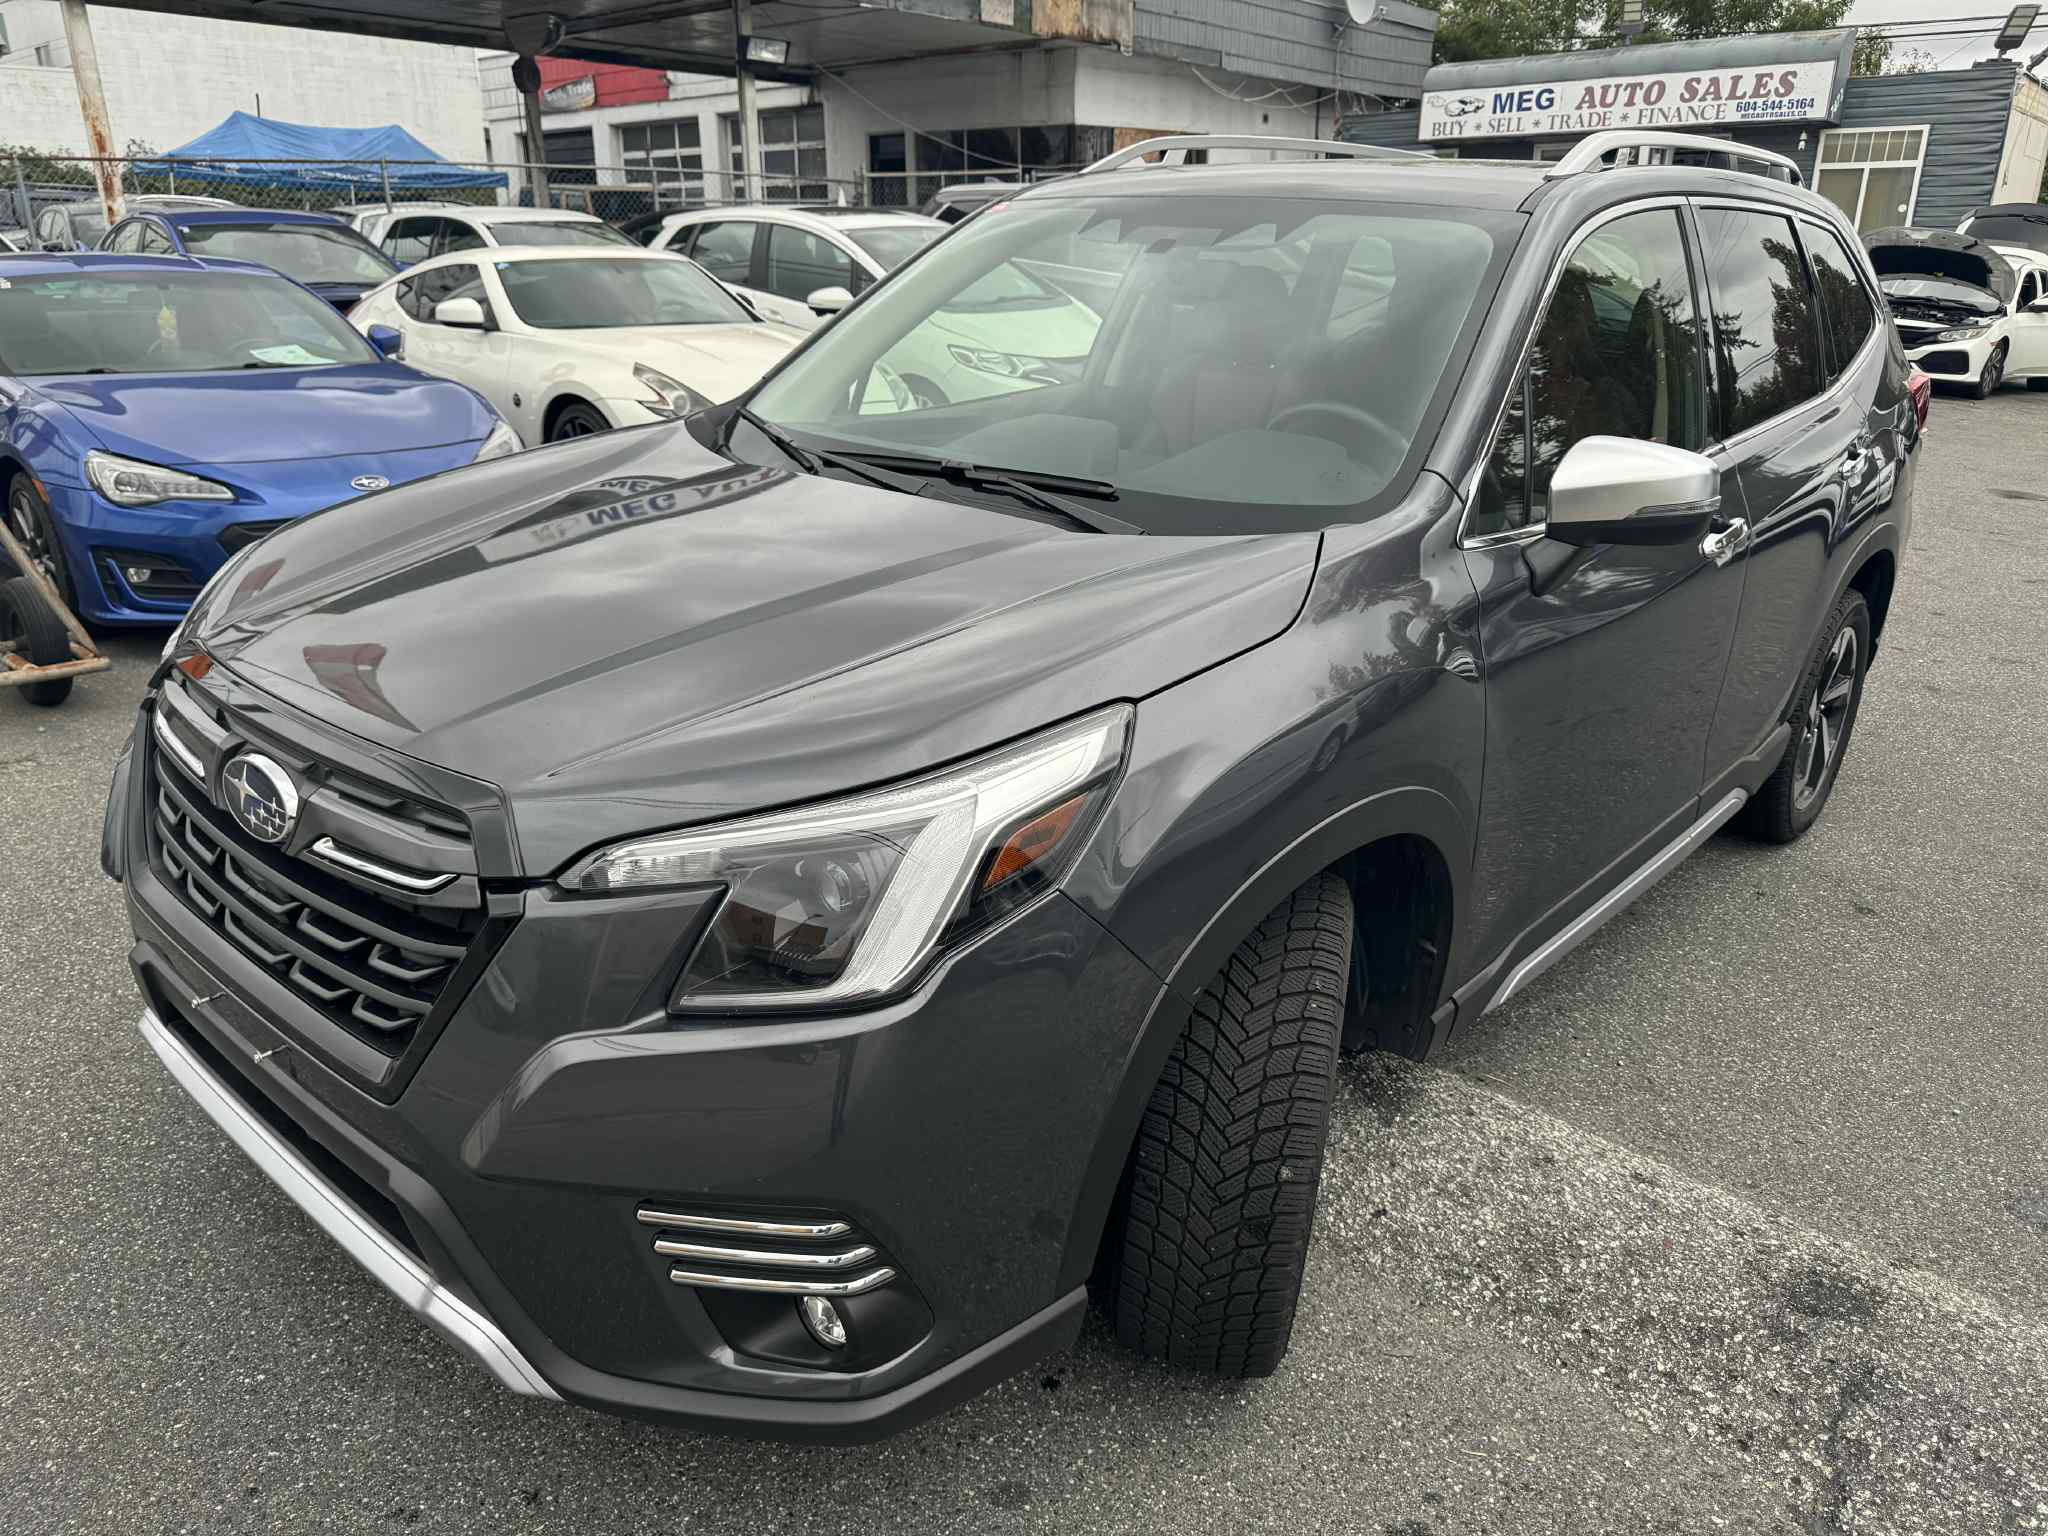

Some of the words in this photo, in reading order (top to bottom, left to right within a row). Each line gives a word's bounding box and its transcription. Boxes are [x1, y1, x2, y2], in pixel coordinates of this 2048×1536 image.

[1491, 87, 1555, 115] MEG
[1574, 79, 1667, 110] AUTO
[1679, 70, 1798, 104] SALES
[1735, 97, 1815, 113] 604-544-5164
[1431, 119, 1467, 137] BUY
[1487, 116, 1525, 134] SELL
[1547, 110, 1613, 130] TRADE
[1637, 103, 1728, 125] FINANCE
